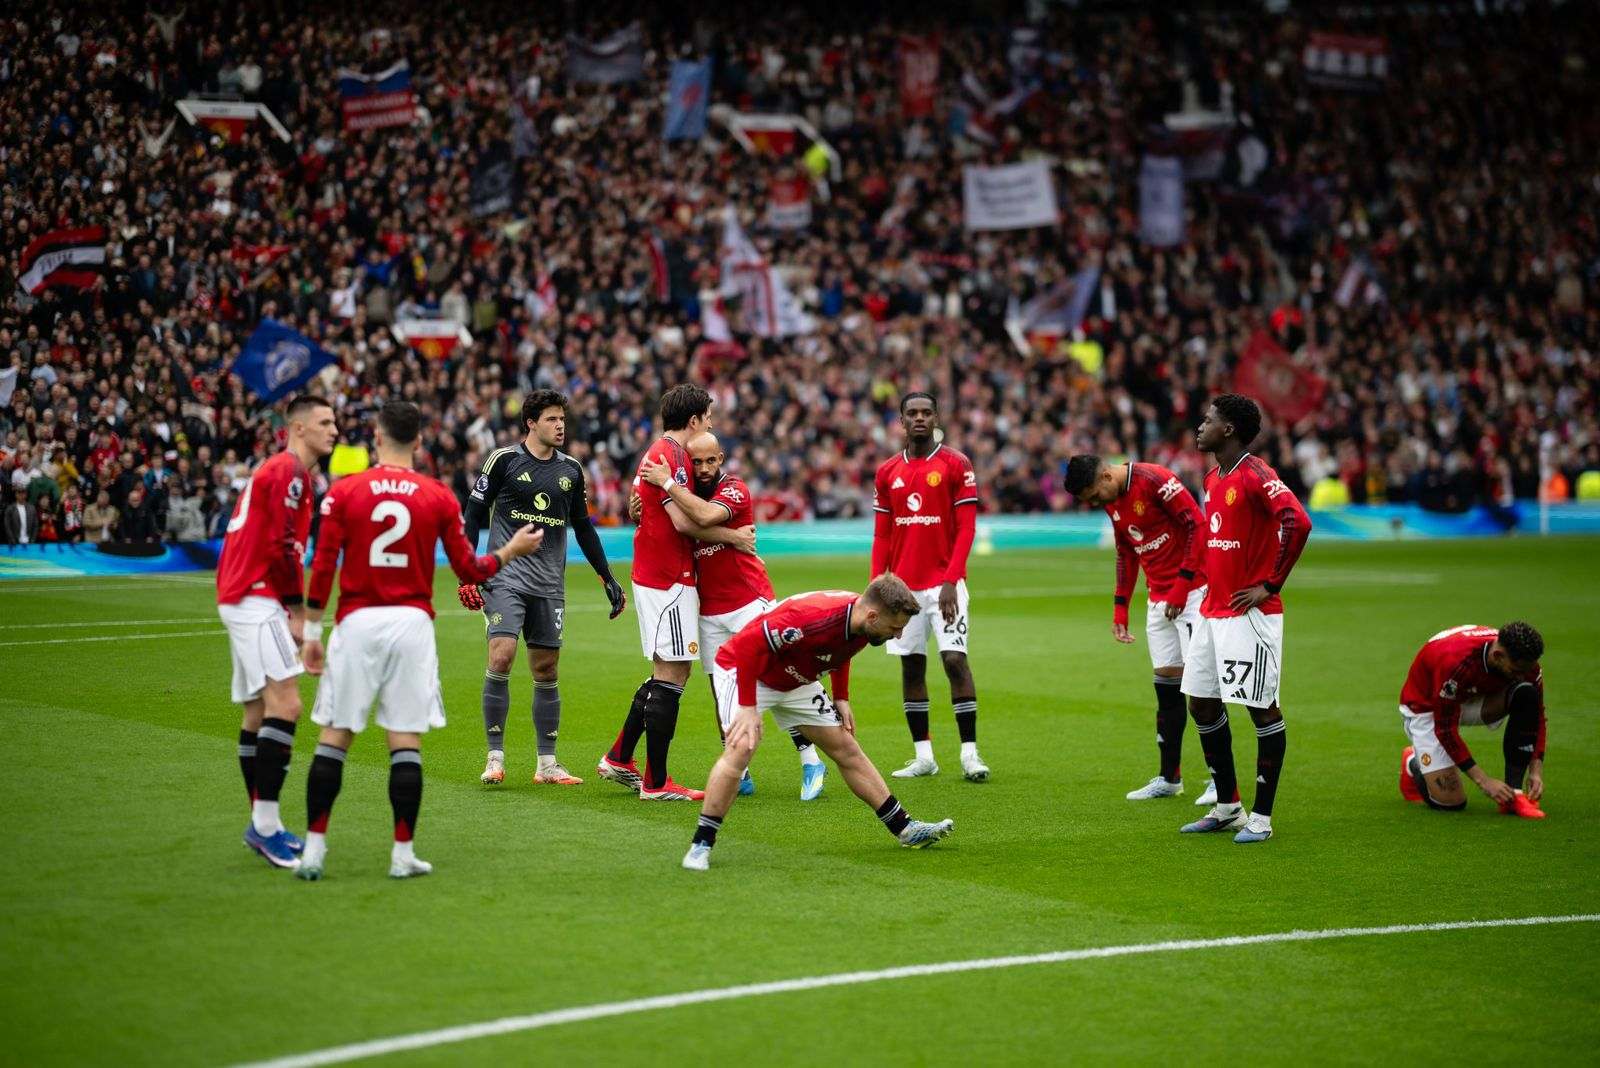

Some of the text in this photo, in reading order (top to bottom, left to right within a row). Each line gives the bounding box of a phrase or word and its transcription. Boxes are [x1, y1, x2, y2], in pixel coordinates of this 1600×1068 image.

[369, 478, 420, 496] DALOT
[511, 509, 565, 527] Snapdragon
[369, 500, 411, 568] 2
[1221, 659, 1253, 686] 37
